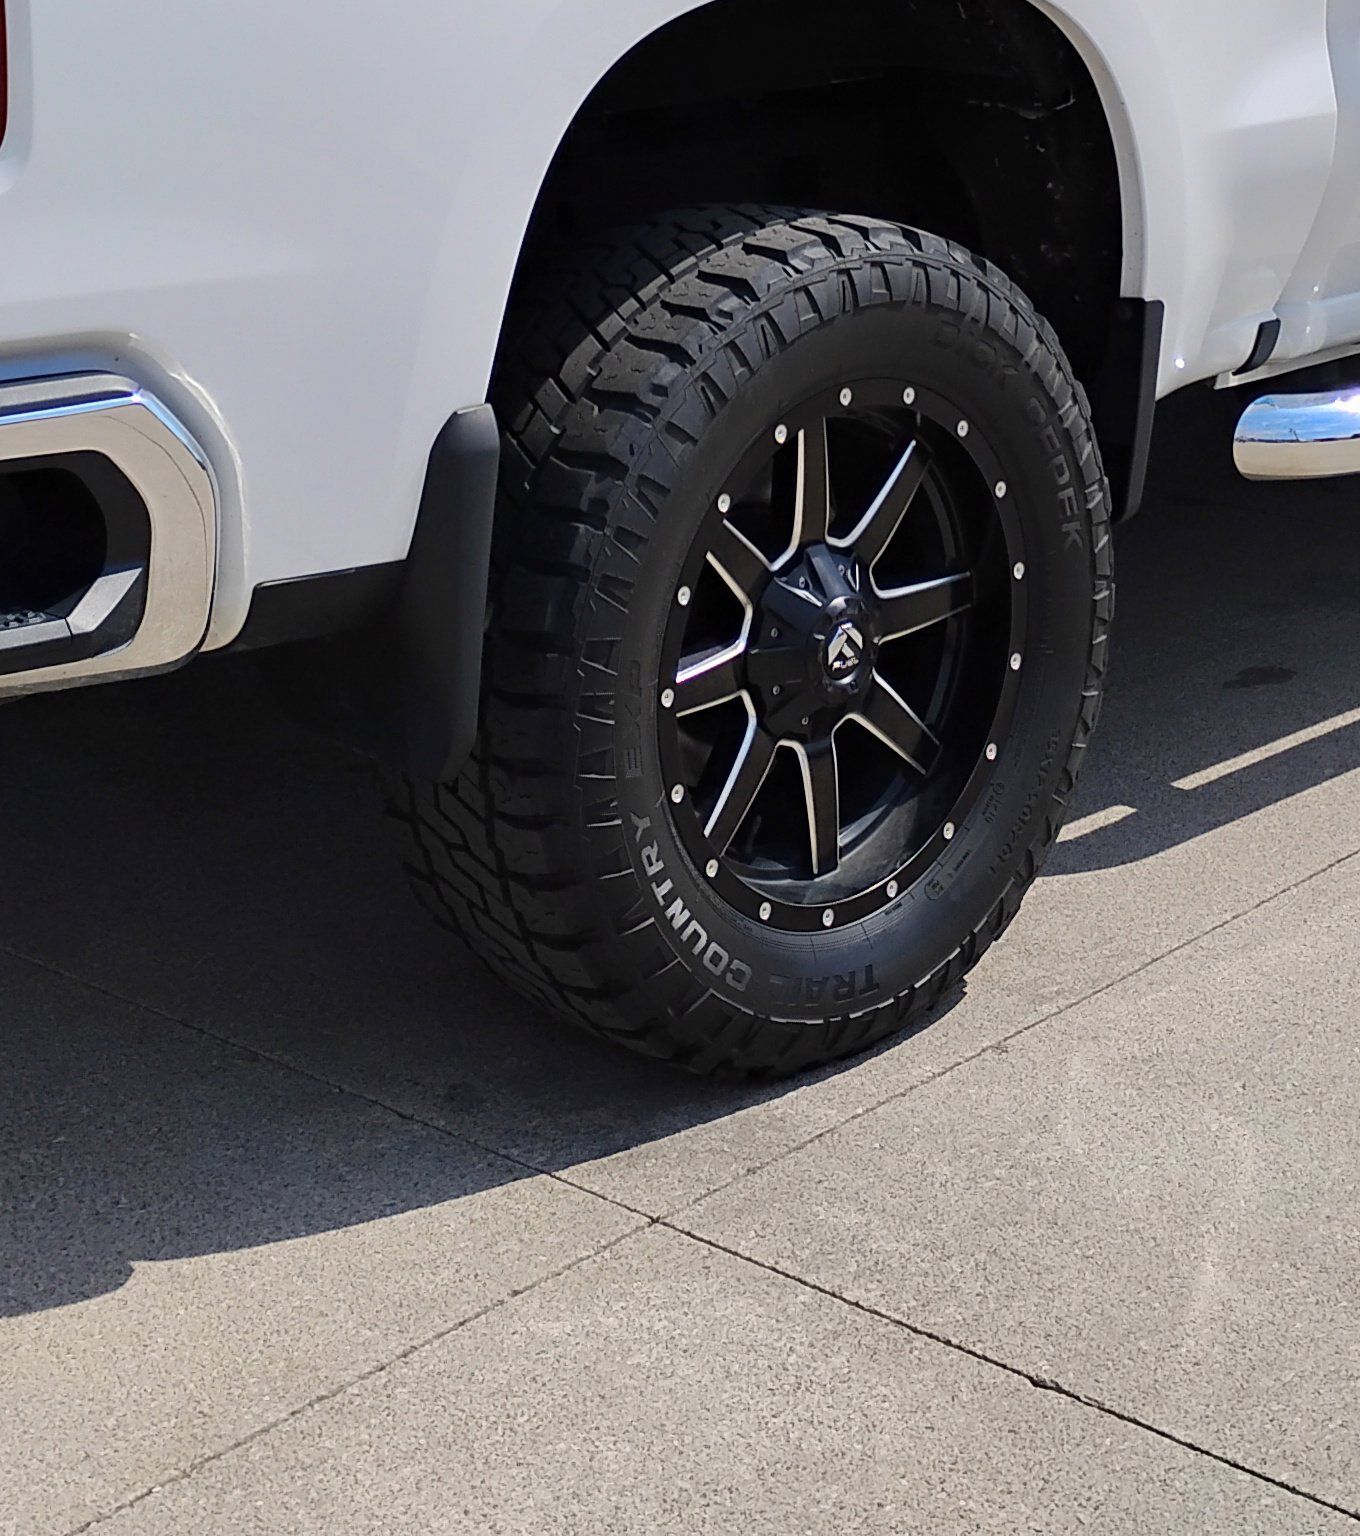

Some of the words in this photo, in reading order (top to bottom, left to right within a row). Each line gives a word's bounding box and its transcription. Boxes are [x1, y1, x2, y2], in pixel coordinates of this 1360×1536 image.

[1025, 395, 1084, 551] CEPEK
[629, 811, 754, 993] COUNTRY
[769, 962, 882, 1008] TRAIL
